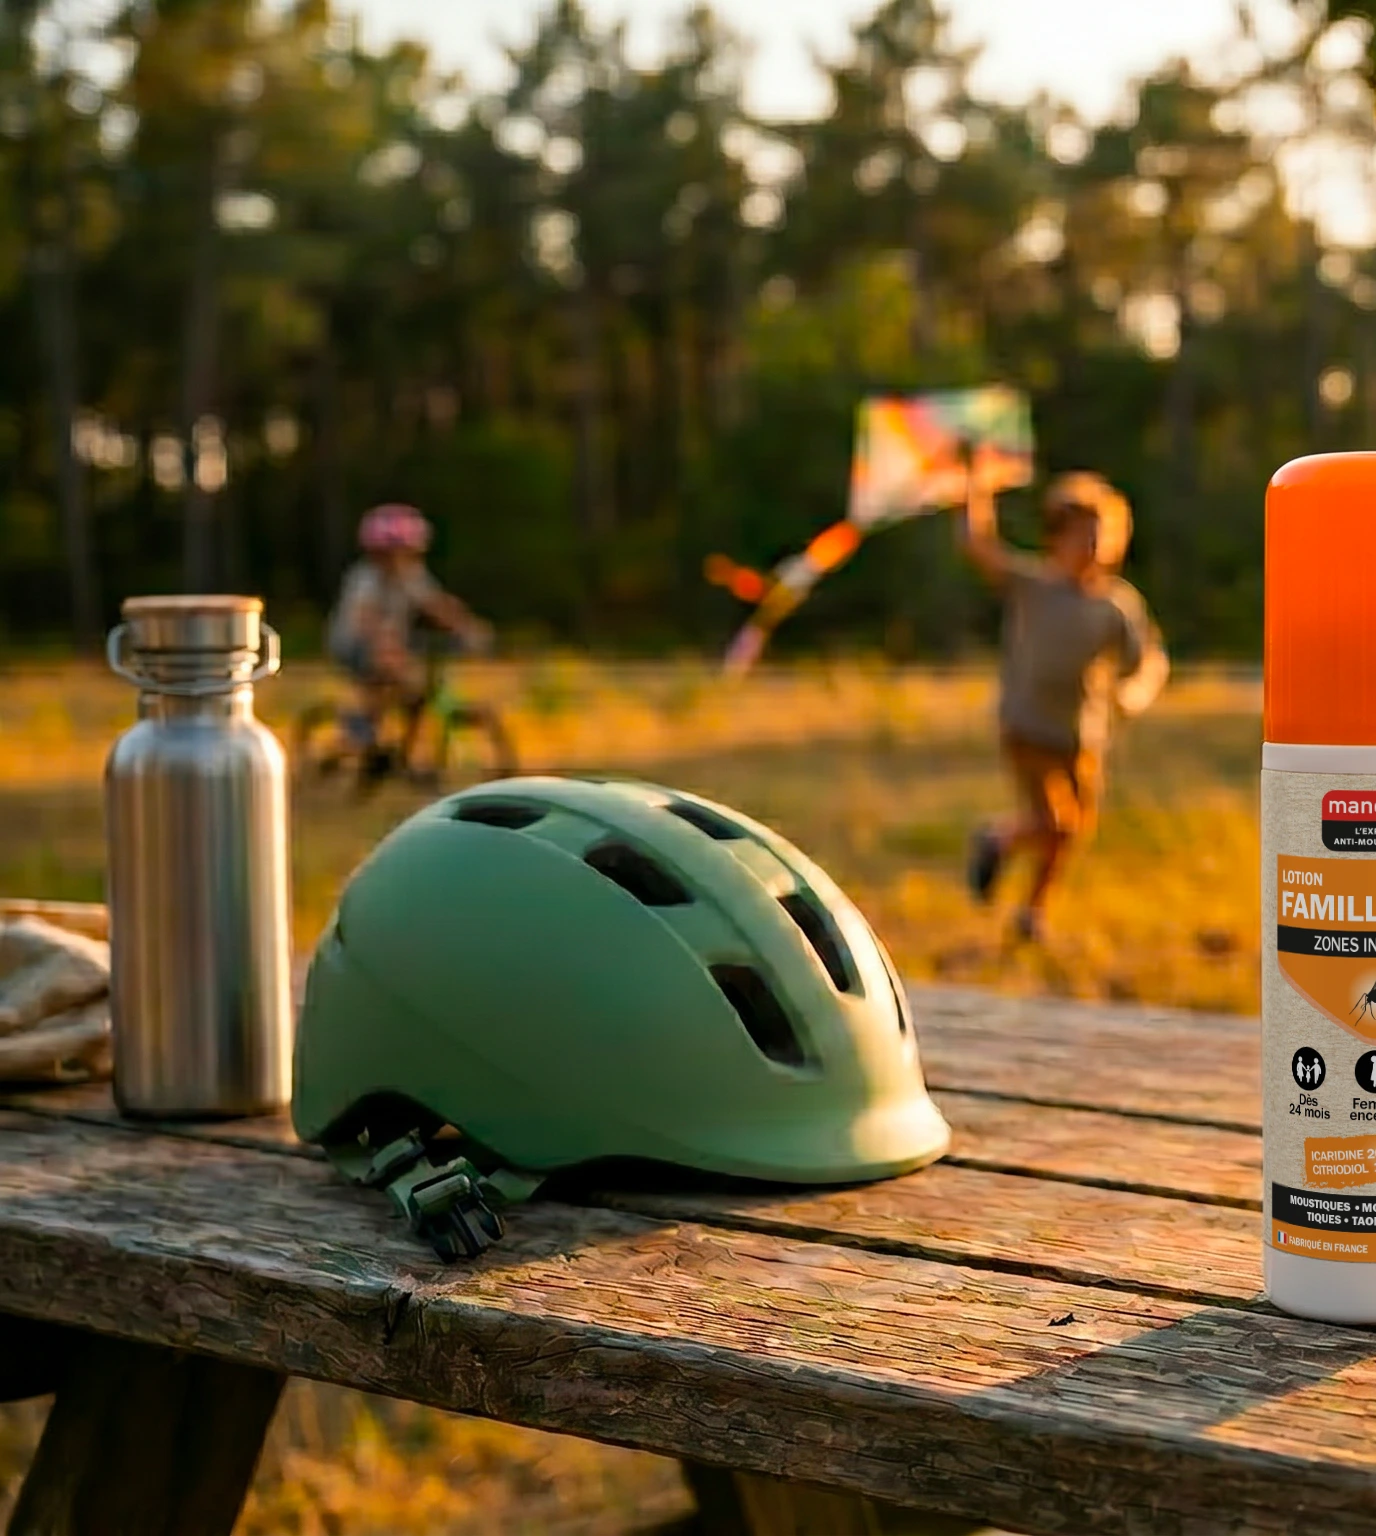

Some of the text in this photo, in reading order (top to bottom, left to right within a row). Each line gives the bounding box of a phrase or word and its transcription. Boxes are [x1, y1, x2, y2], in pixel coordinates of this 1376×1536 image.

[1282, 869, 1323, 886] LOTION
[1314, 935, 1359, 953] ZONES
[1299, 1093, 1318, 1107] Dès
[1289, 1103, 1331, 1119] 24 mois
[1311, 1149, 1365, 1161] ICARIDINE
[1312, 1163, 1369, 1175] CITRIODIOL
[1290, 1195, 1351, 1212] MOUSTIQUES
[1307, 1211, 1342, 1225] TIQUES
[1288, 1235, 1369, 1254] FABRIQUÉ EN FRANCE
